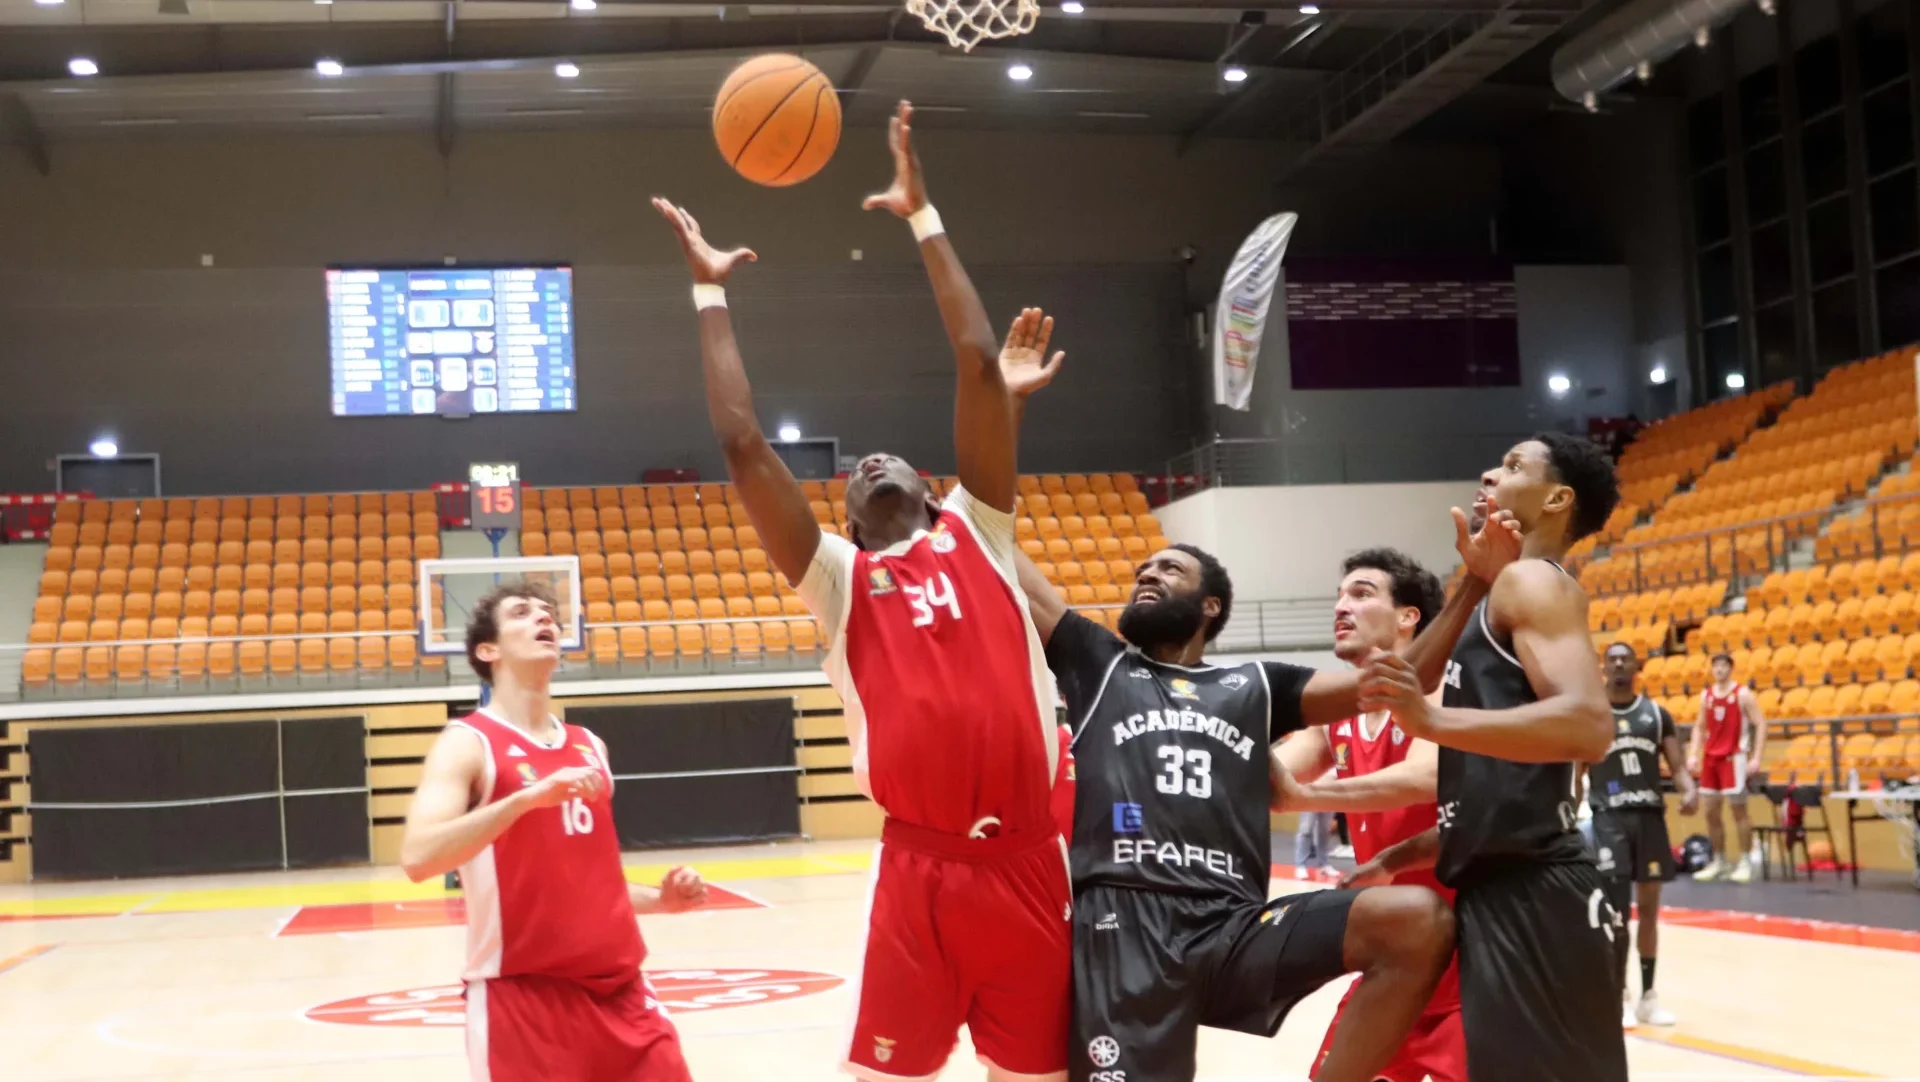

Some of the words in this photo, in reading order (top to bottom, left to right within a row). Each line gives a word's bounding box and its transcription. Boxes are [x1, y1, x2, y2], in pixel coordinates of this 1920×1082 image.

[476, 486, 514, 514] 15
[903, 571, 962, 628] 34
[1112, 706, 1255, 761] ACADÉMICA
[1156, 744, 1212, 799] 33
[1620, 751, 1642, 777] 10
[561, 797, 594, 836] 16
[1113, 839, 1244, 880] EFAPEL
